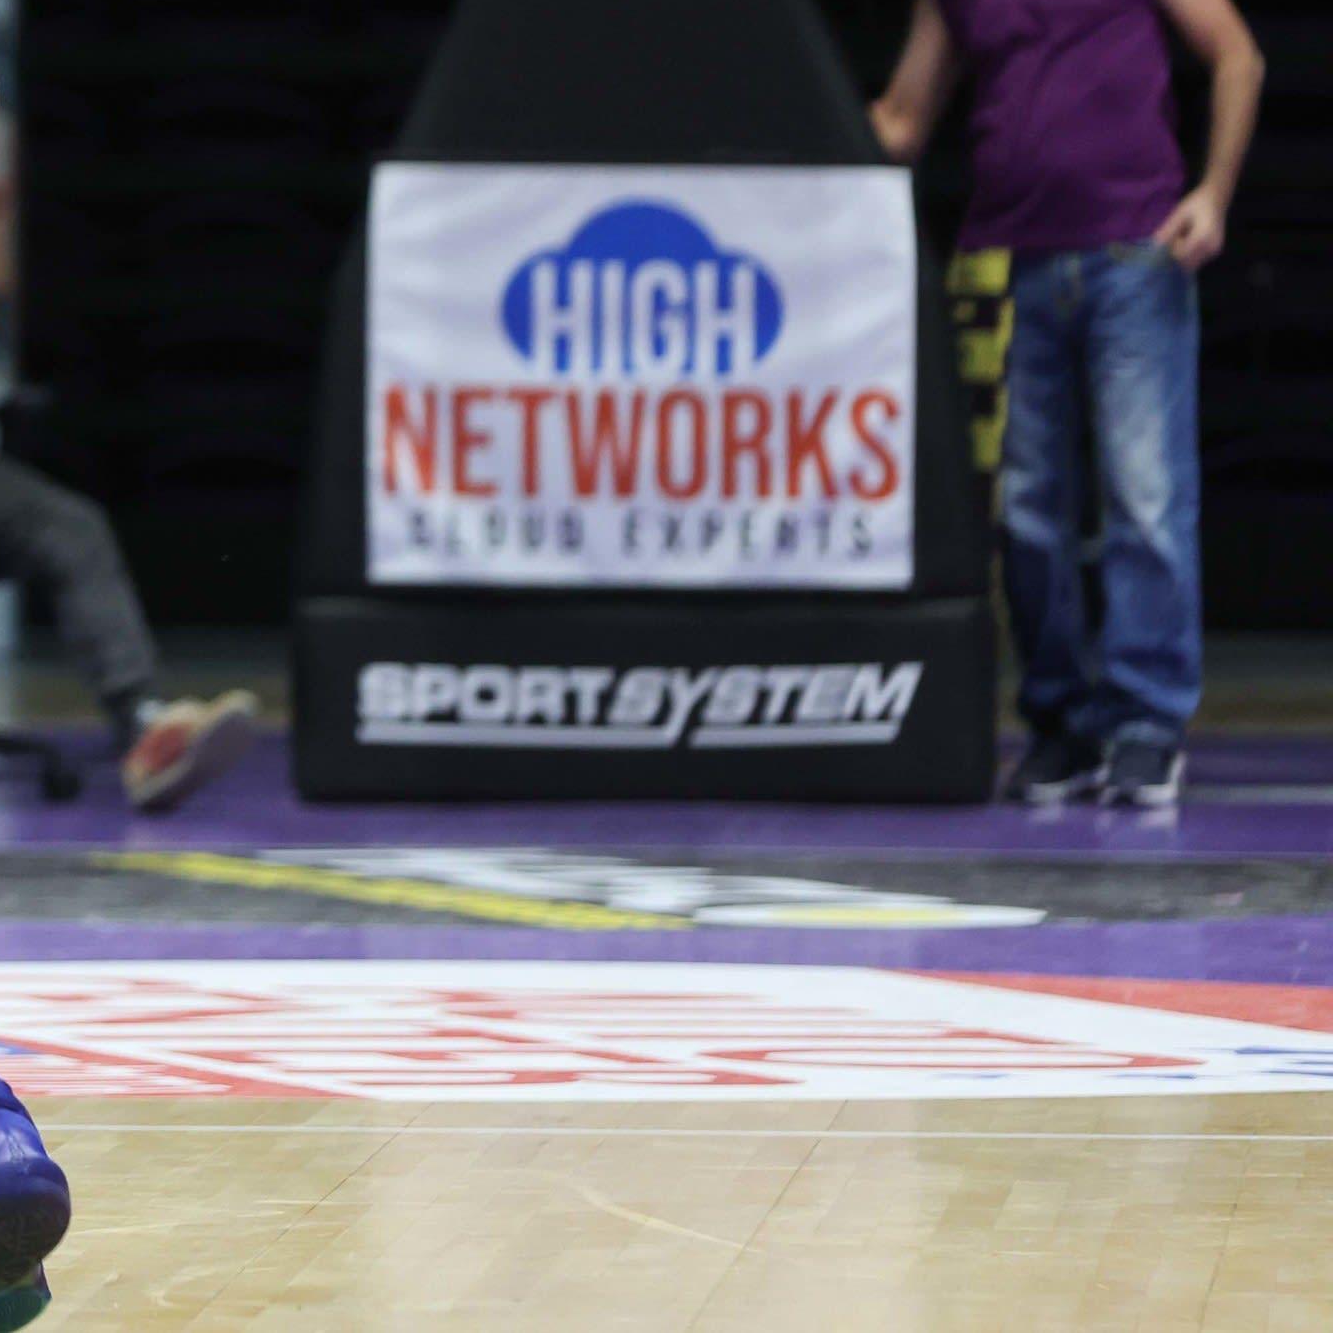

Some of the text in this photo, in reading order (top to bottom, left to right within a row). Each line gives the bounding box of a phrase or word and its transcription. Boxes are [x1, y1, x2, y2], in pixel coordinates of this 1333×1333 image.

[527, 257, 758, 378] HIGH
[381, 385, 902, 501] NETWORKS
[406, 506, 874, 561] CLOUD EXPERTS
